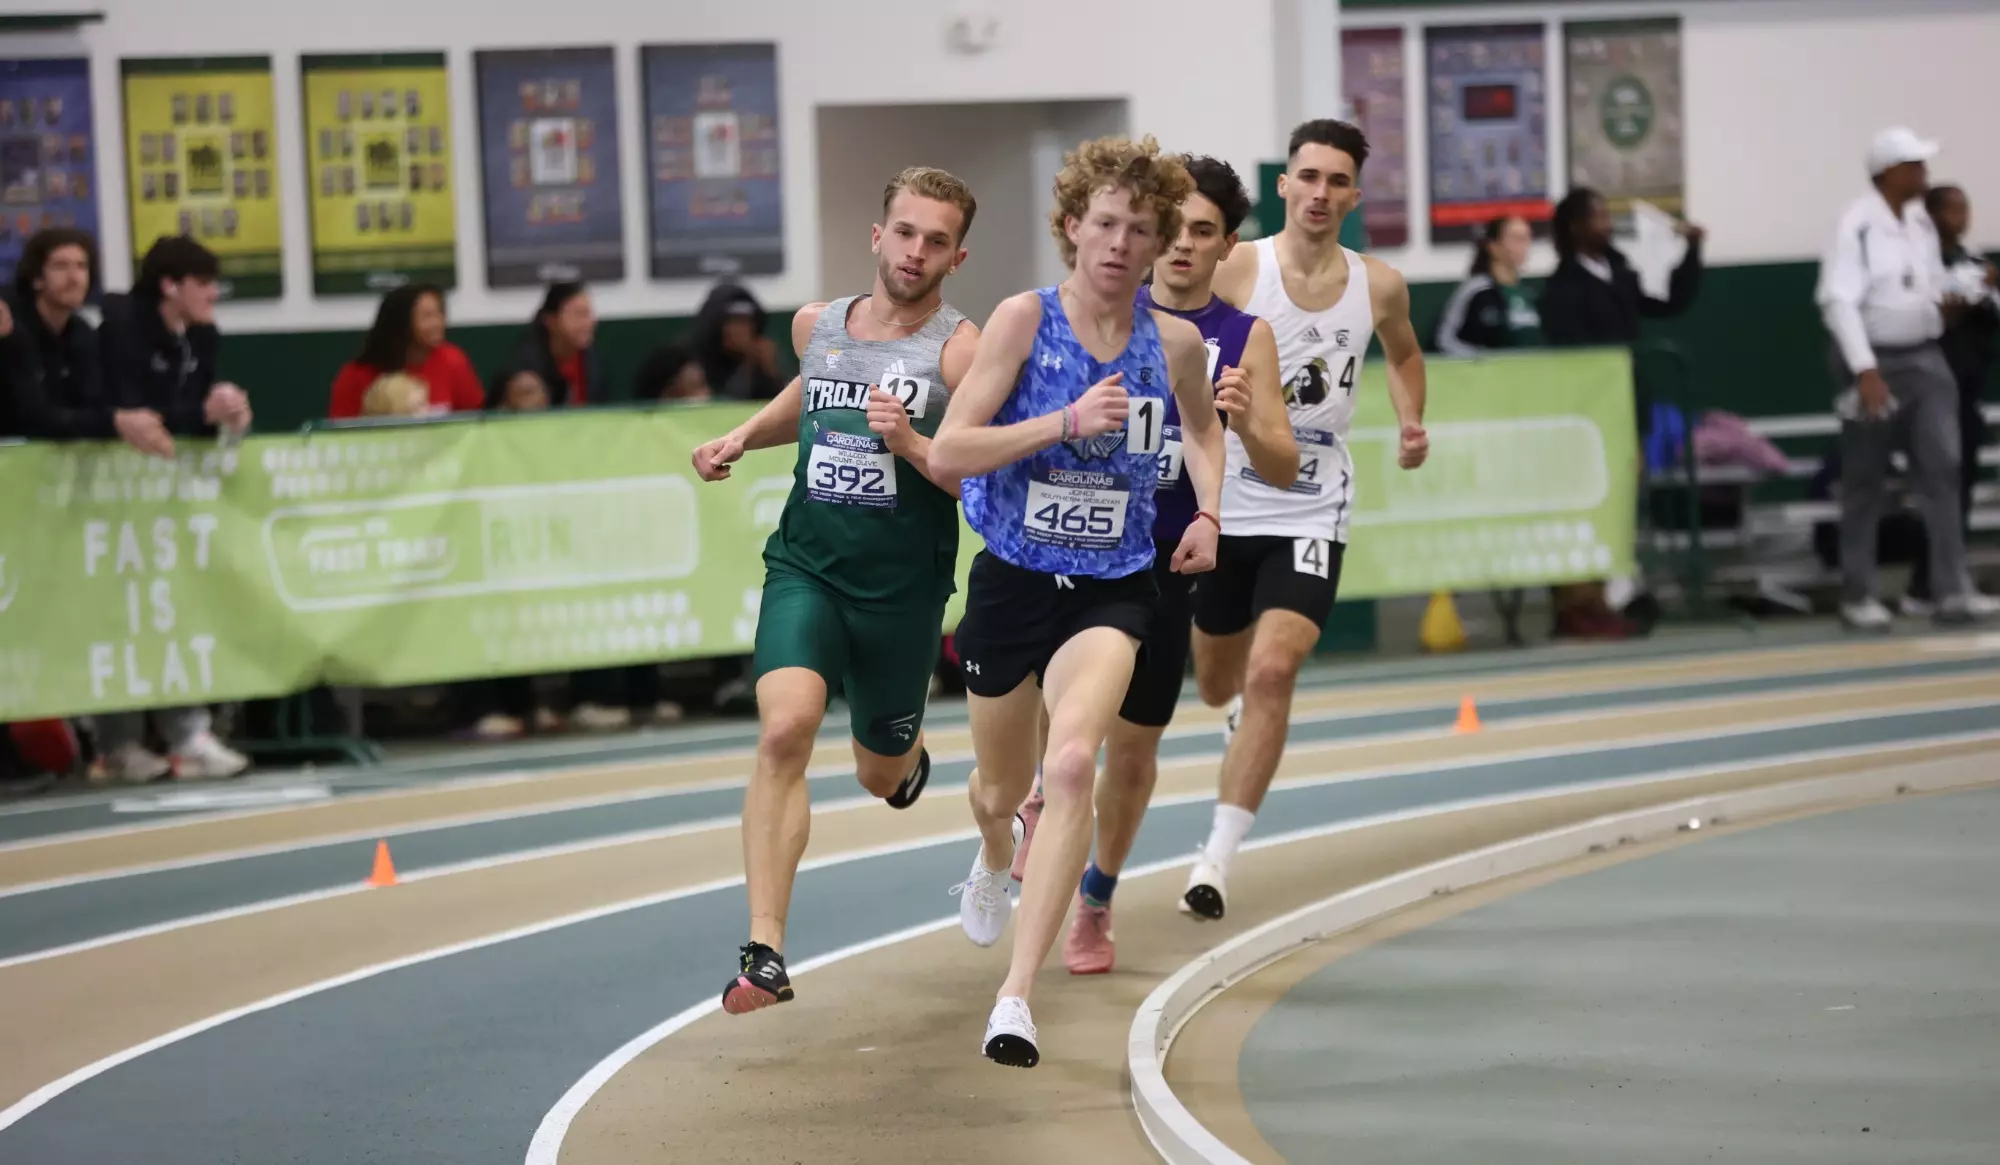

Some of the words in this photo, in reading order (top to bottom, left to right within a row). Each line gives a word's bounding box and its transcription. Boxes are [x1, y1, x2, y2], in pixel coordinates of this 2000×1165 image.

[1339, 356, 1355, 396] 4
[888, 377, 918, 416] 12
[826, 434, 879, 450] CAROLINAS
[1138, 401, 1152, 451] 1
[828, 455, 853, 465] MOUNT
[838, 450, 868, 460] WILLCOX
[815, 461, 885, 494] 392
[1048, 472, 1114, 486] CAROLINAS
[1034, 502, 1114, 535] 465
[83, 512, 218, 577] FAST
[1302, 539, 1323, 573] 4
[125, 577, 176, 636] IS
[88, 633, 216, 699] FLAT
